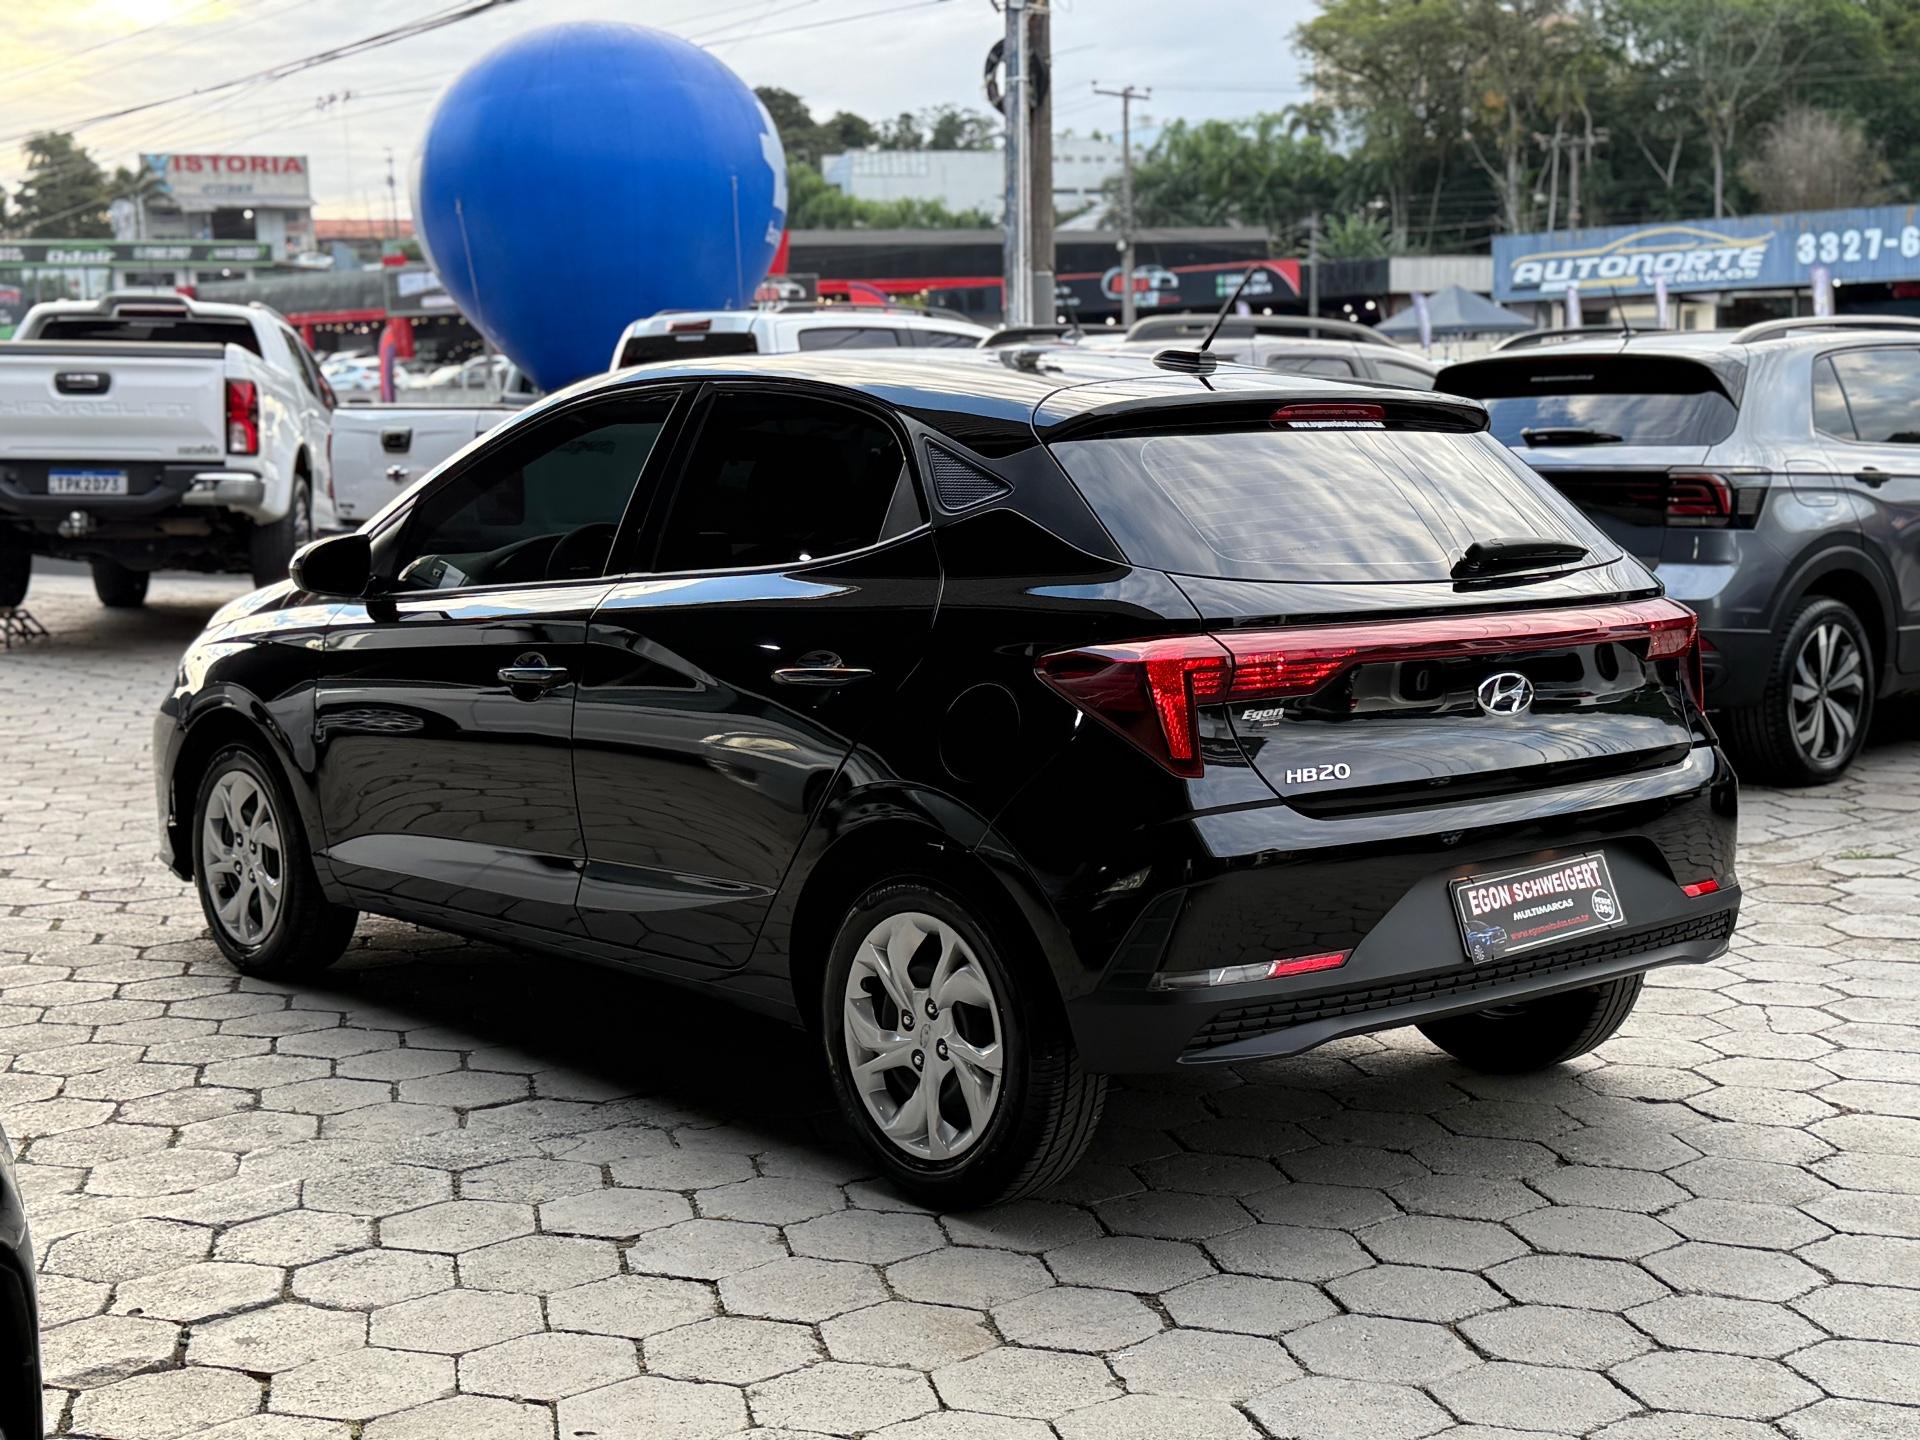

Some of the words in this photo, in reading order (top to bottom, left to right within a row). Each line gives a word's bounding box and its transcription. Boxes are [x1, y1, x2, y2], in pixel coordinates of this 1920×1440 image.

[1241, 707, 1285, 721] Egon
[1286, 762, 1351, 784] HB20
[1467, 884, 1513, 916] EGON
[1512, 860, 1602, 902] SCHWEIGERT
[1513, 898, 1574, 921] MULTIMARCAS
